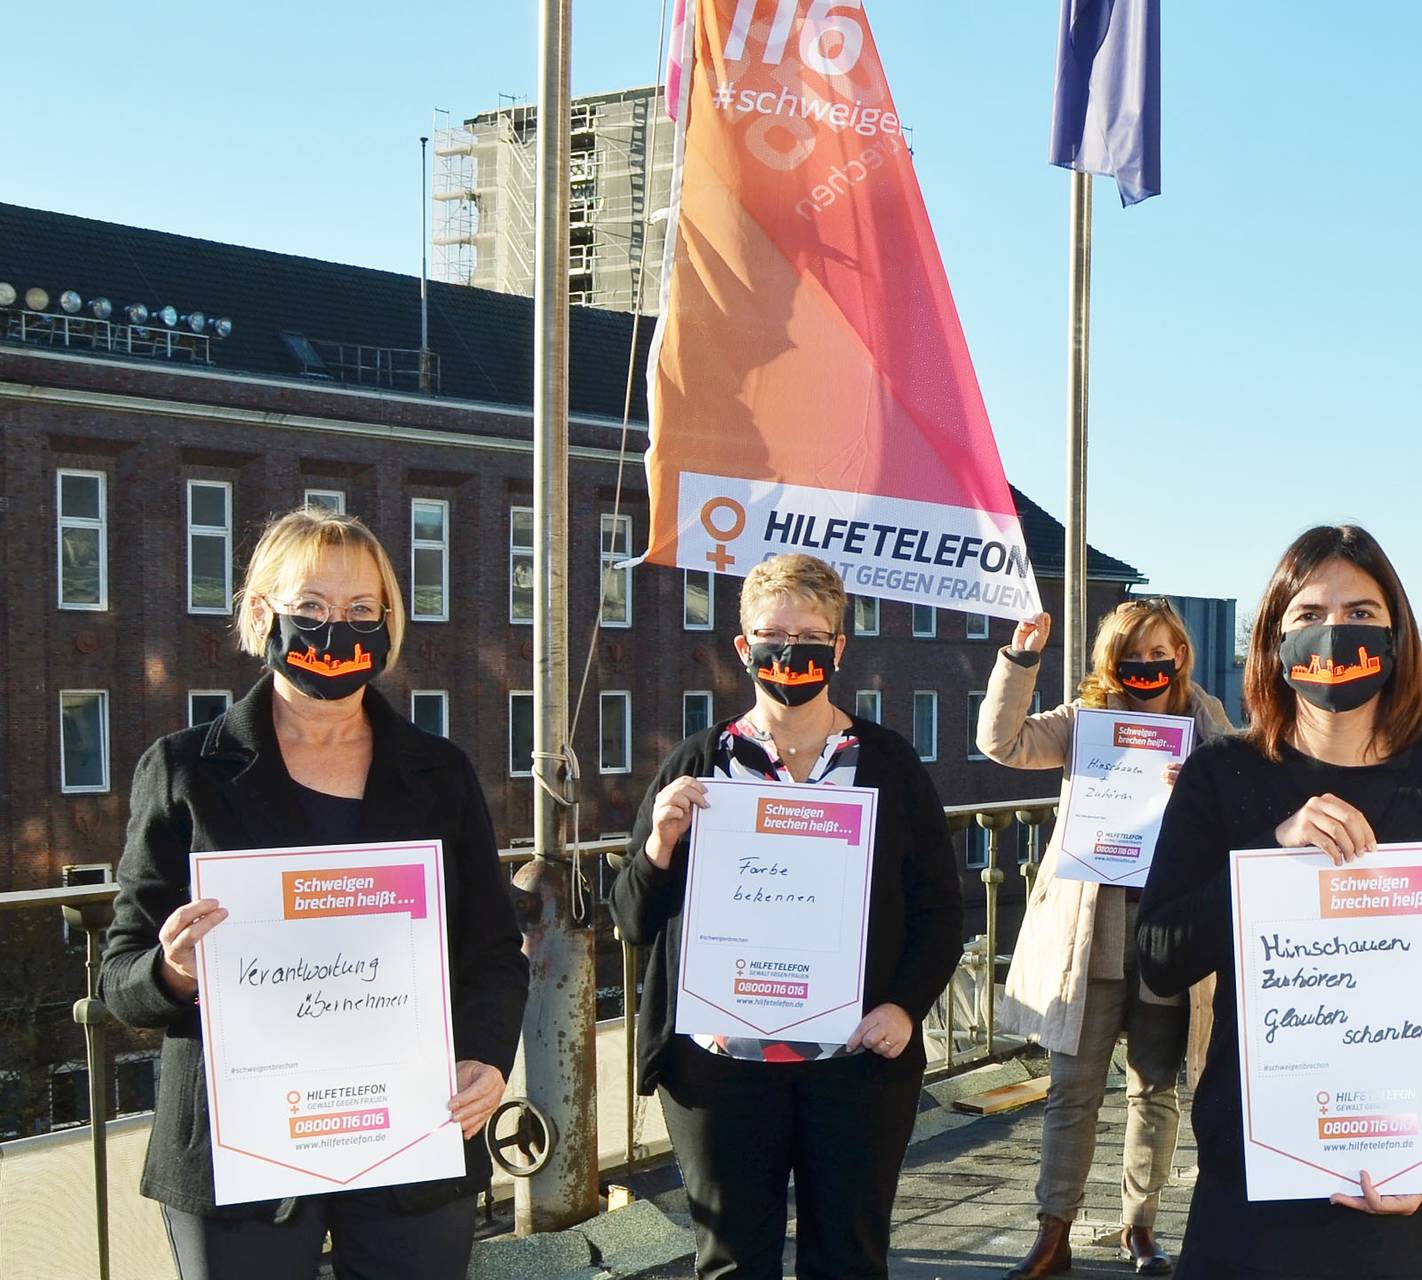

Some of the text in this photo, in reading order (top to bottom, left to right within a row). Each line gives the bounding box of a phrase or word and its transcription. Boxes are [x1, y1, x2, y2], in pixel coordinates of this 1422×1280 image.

[722, 0, 863, 76] 116
[763, 510, 1029, 578] HILFETELEFON
[856, 565, 934, 594] GEGEN
[936, 576, 1029, 610] FRAUEN
[1118, 726, 1157, 737] Schweigen
[764, 803, 825, 818] Schweigen
[763, 817, 808, 831] brechen
[739, 856, 789, 876] Farbe
[293, 876, 374, 893] Schweigen
[1330, 876, 1409, 891] Schweigen
[733, 885, 817, 903] bekennen
[1330, 895, 1390, 910] brechen
[295, 895, 357, 911] brechen
[1260, 934, 1411, 961] Hinschauen
[239, 952, 379, 985] Verantwortung
[749, 961, 810, 972] HILFETELEFON
[1261, 967, 1357, 989] Zuhören
[738, 982, 804, 995] 08000 116 016
[296, 990, 408, 1018] übernehmen
[1264, 1004, 1349, 1043] Glauben
[306, 1084, 387, 1101] HILFETELEFON
[295, 1112, 385, 1134] 08000 116 016
[1323, 1121, 1368, 1135] 08000
[1369, 1120, 1388, 1133] 116
[1323, 1140, 1414, 1152] www.hilfetelefon.de
